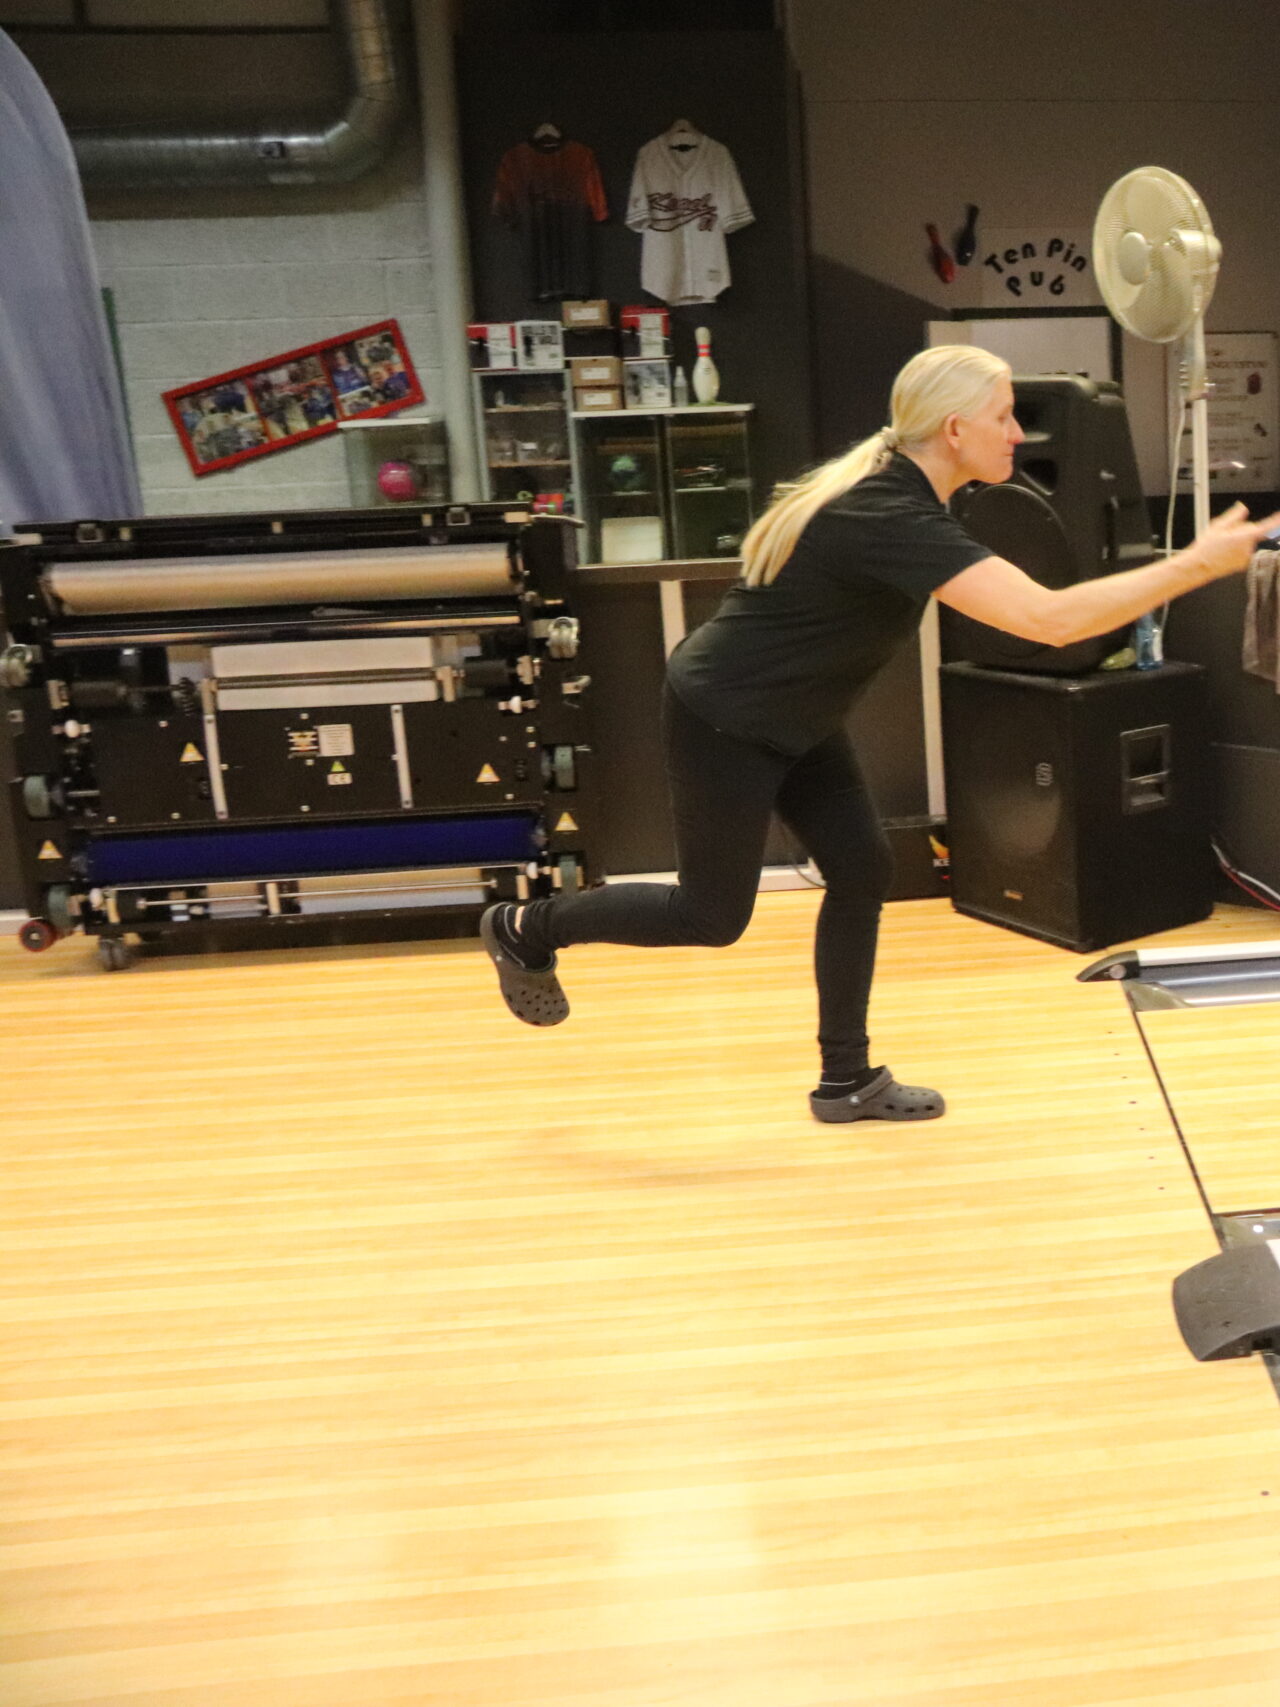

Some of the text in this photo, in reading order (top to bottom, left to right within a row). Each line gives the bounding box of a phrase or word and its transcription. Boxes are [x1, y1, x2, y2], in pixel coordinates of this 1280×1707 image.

[984, 239, 1087, 274] Ten Pin
[1006, 271, 1065, 297] Pub
